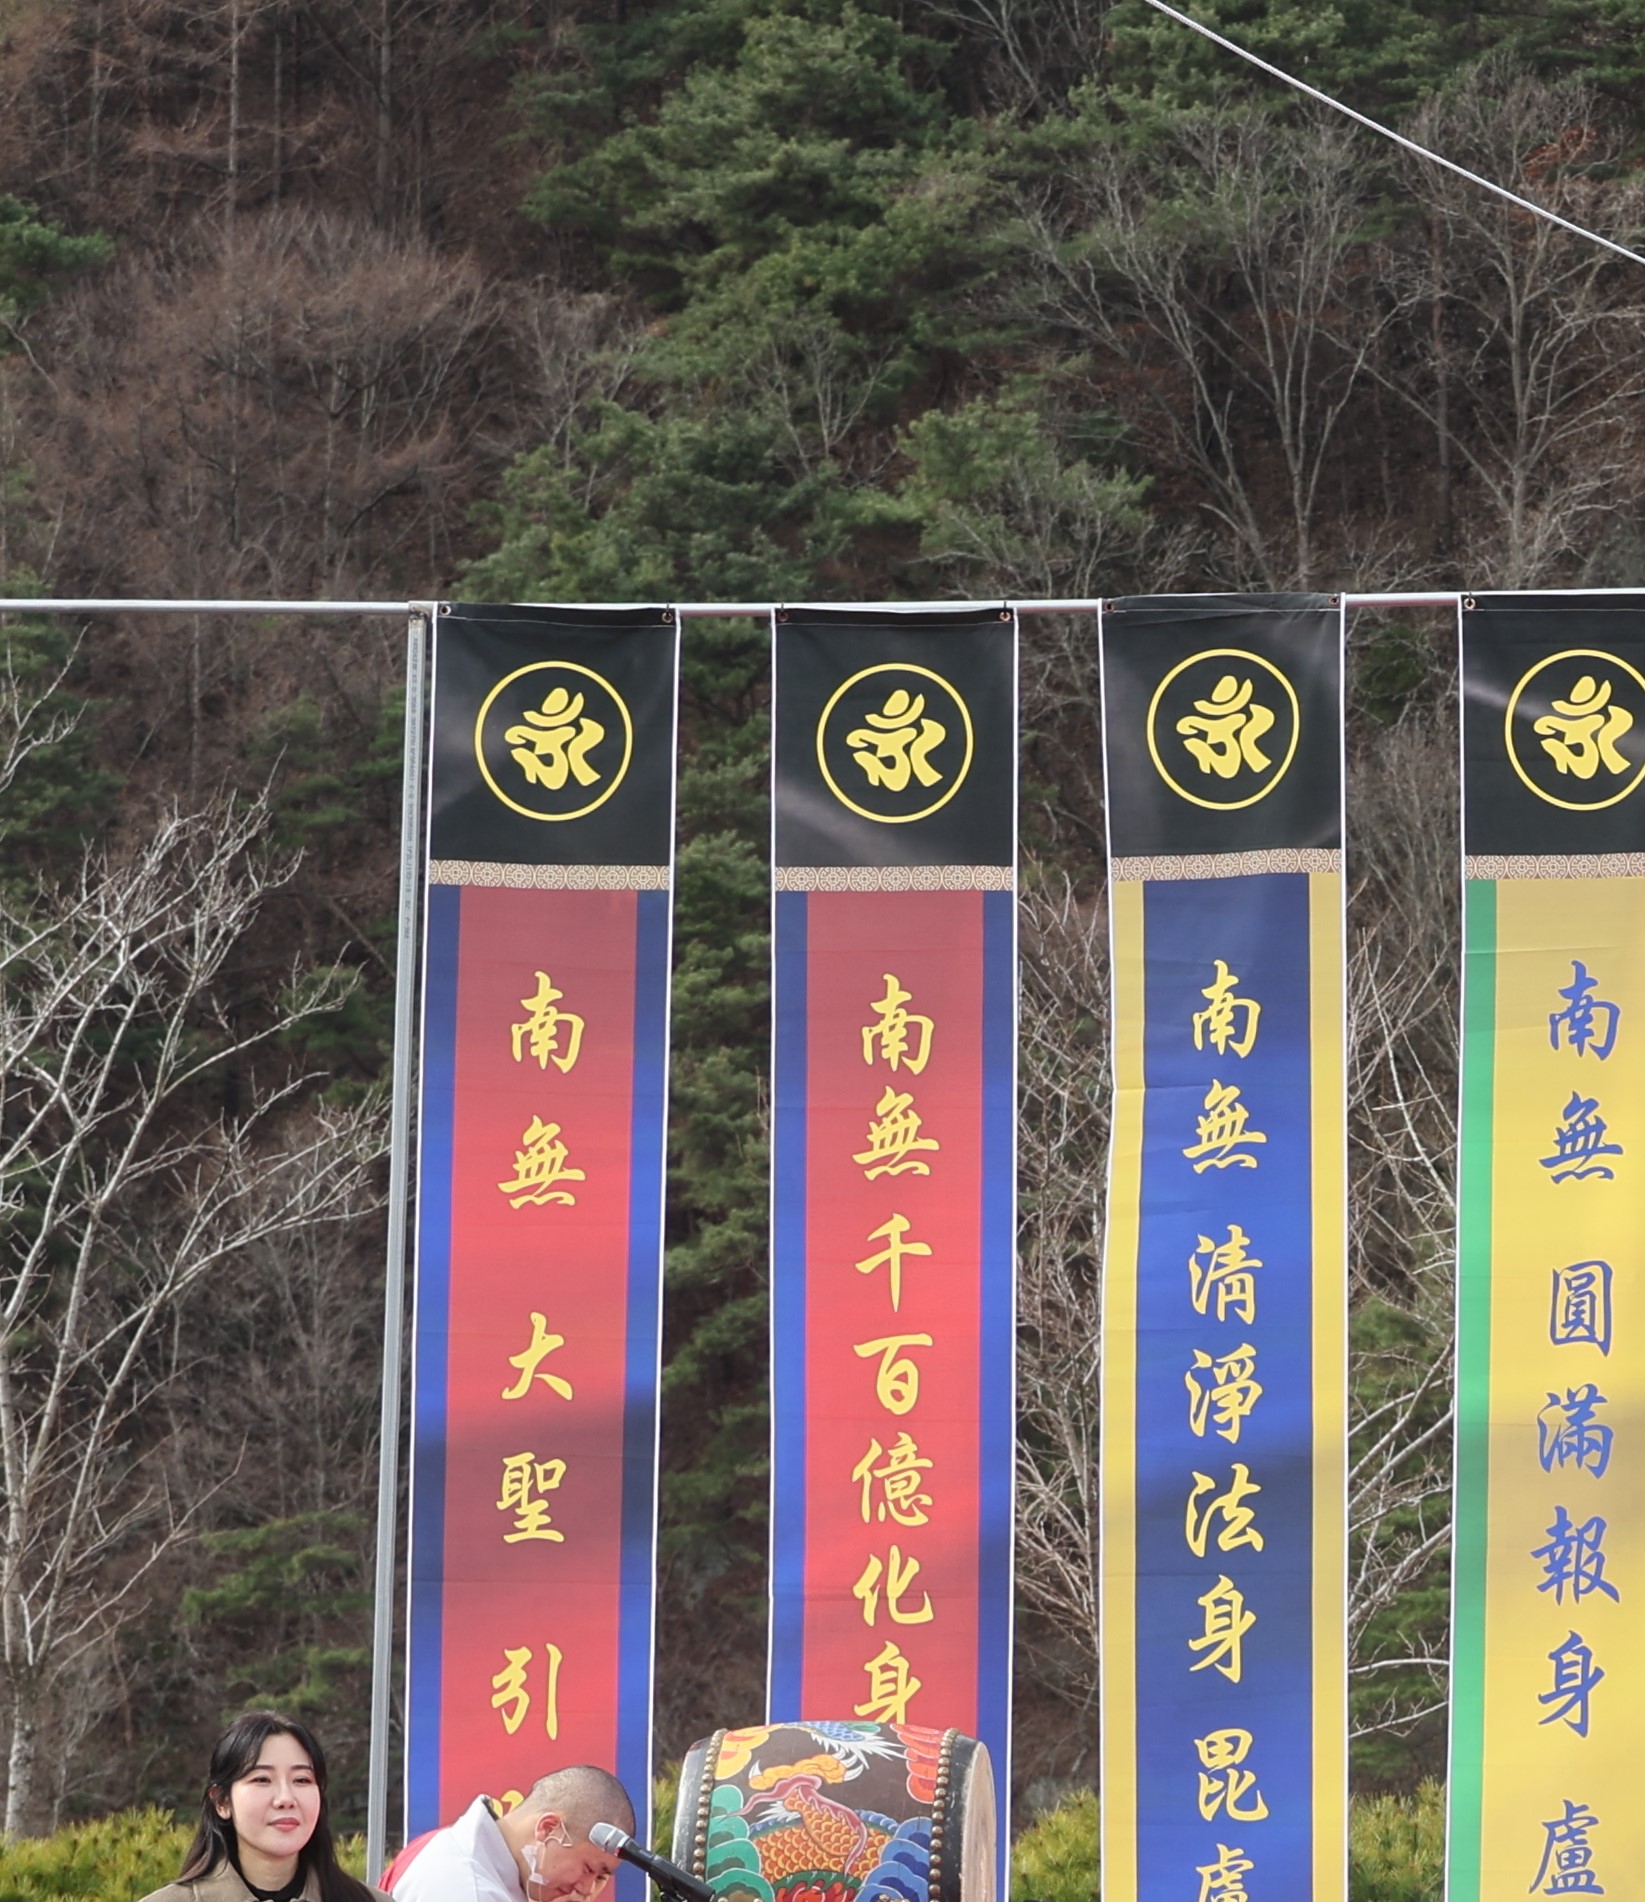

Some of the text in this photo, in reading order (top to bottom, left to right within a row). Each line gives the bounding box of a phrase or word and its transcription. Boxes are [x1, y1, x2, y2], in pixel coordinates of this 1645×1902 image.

[491, 971, 586, 1816] 南無大聖引
